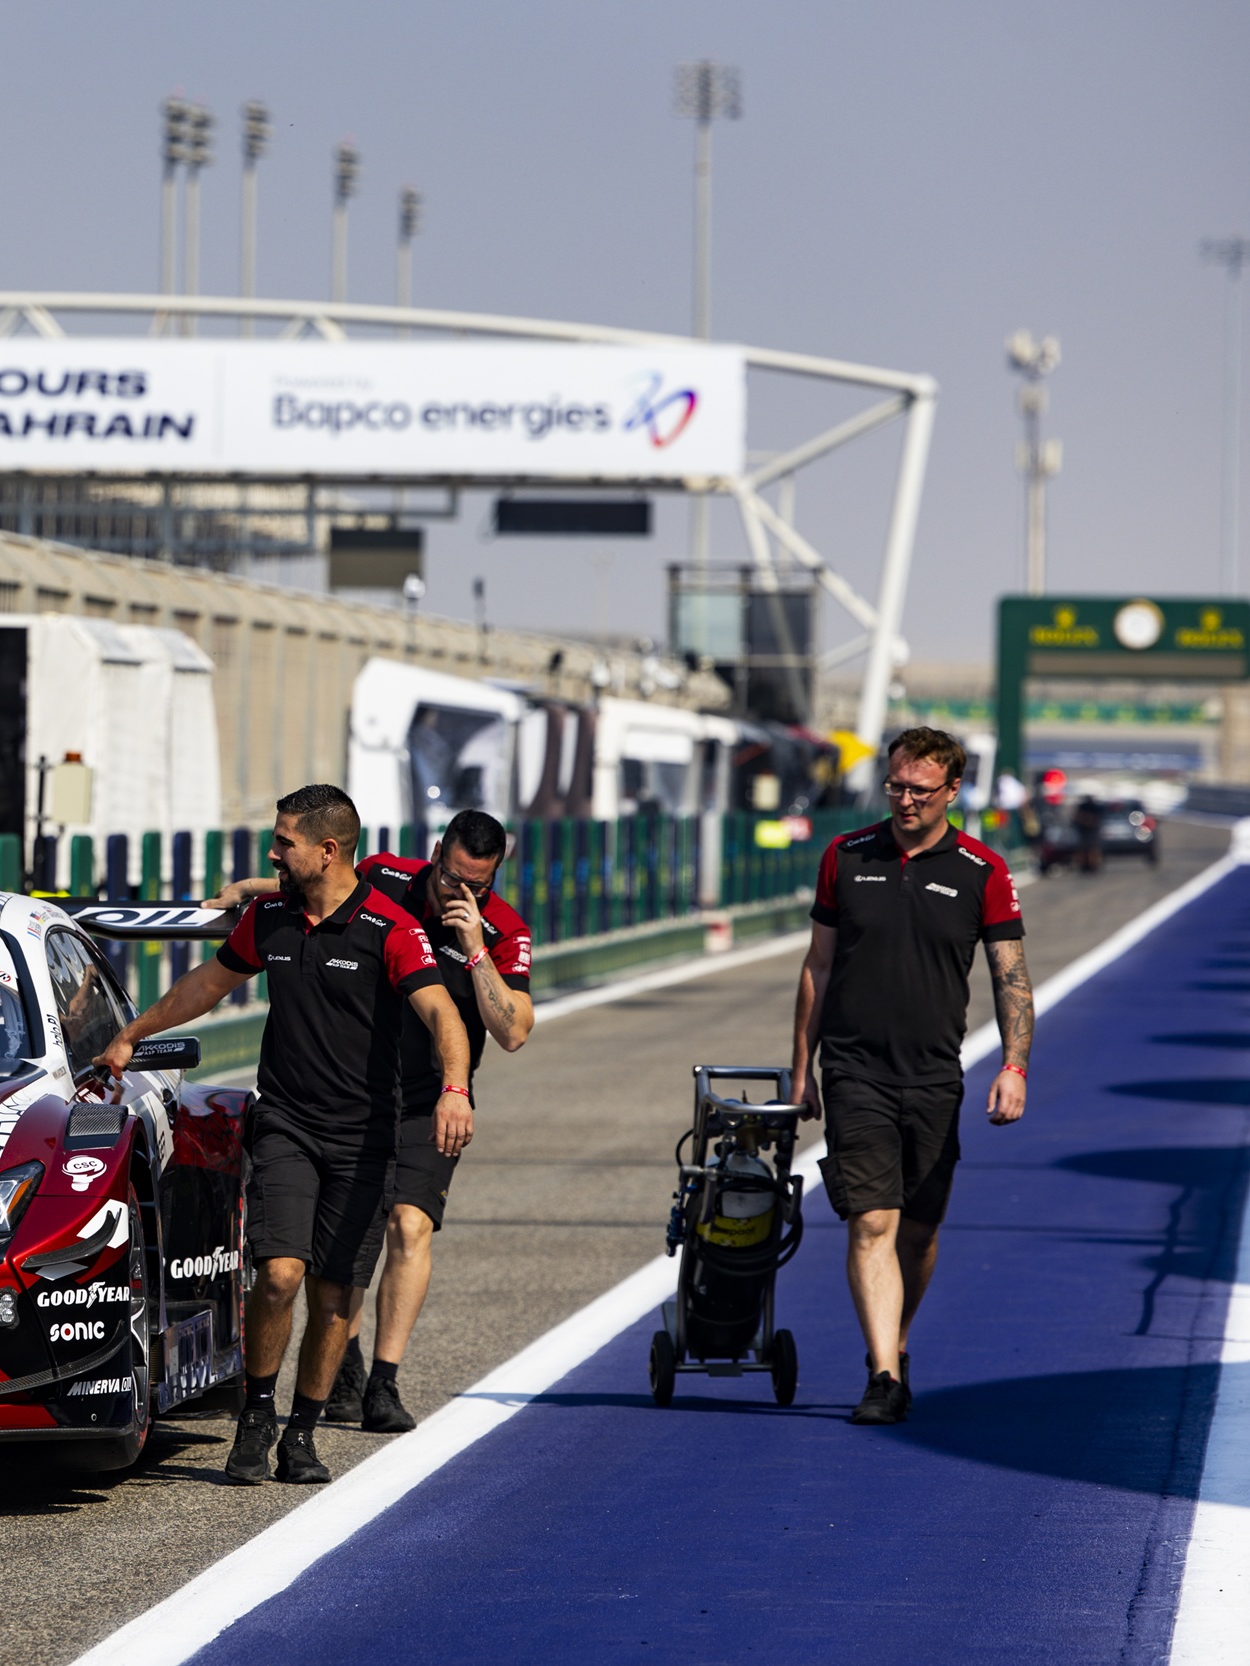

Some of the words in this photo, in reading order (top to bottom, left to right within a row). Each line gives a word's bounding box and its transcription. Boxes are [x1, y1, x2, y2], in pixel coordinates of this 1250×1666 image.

[272, 394, 412, 438] Bapco
[421, 396, 611, 441] energies
[78, 909, 200, 926] OIL
[73, 1160, 98, 1170] CSC
[170, 1249, 239, 1280] GOODYEAR
[37, 1284, 131, 1308] GOODYEAR
[50, 1320, 105, 1342] SONIC
[66, 1379, 120, 1396] MINERVA
